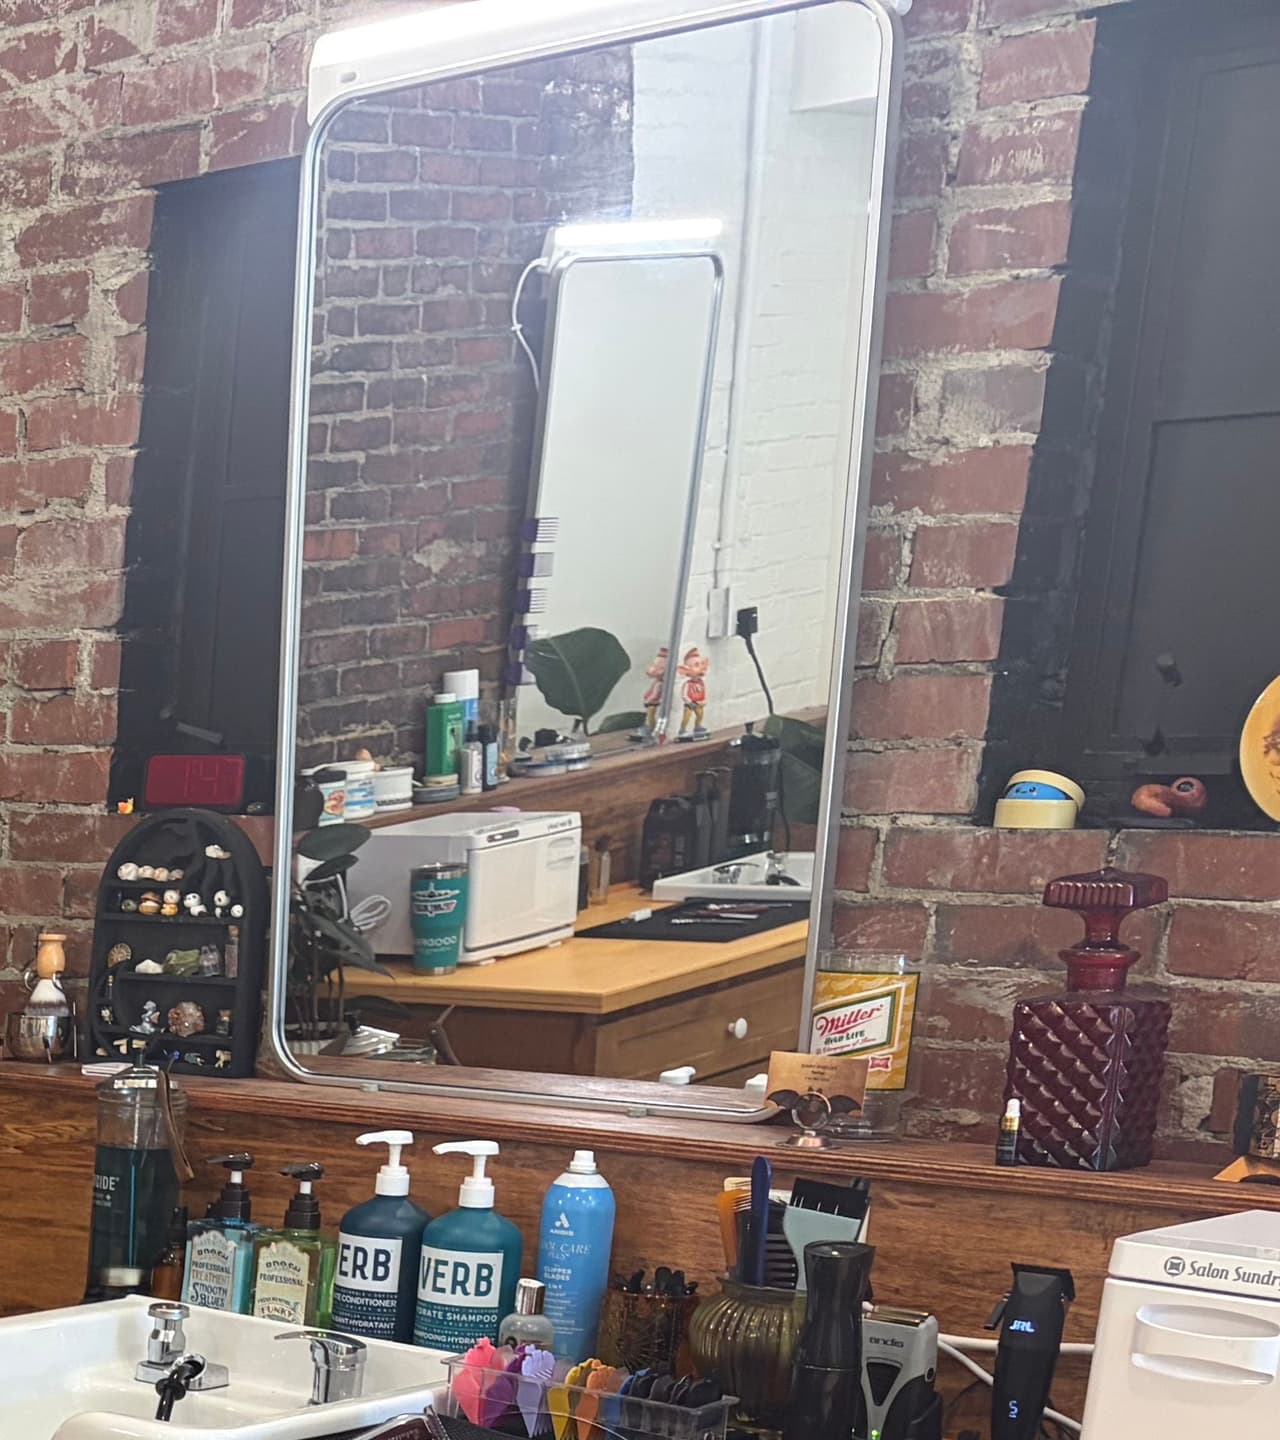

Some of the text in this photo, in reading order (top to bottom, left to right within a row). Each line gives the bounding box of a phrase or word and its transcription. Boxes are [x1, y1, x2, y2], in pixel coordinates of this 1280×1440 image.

[816, 1006, 881, 1037] Miller
[339, 1243, 391, 1282] ERB
[422, 1255, 494, 1297] VERB
[1188, 1260, 1280, 1292] Salon Sundr
[342, 1294, 397, 1308] CONDITIONER
[446, 1312, 498, 1323] SHAMPOO
[870, 1335, 905, 1349] andis
